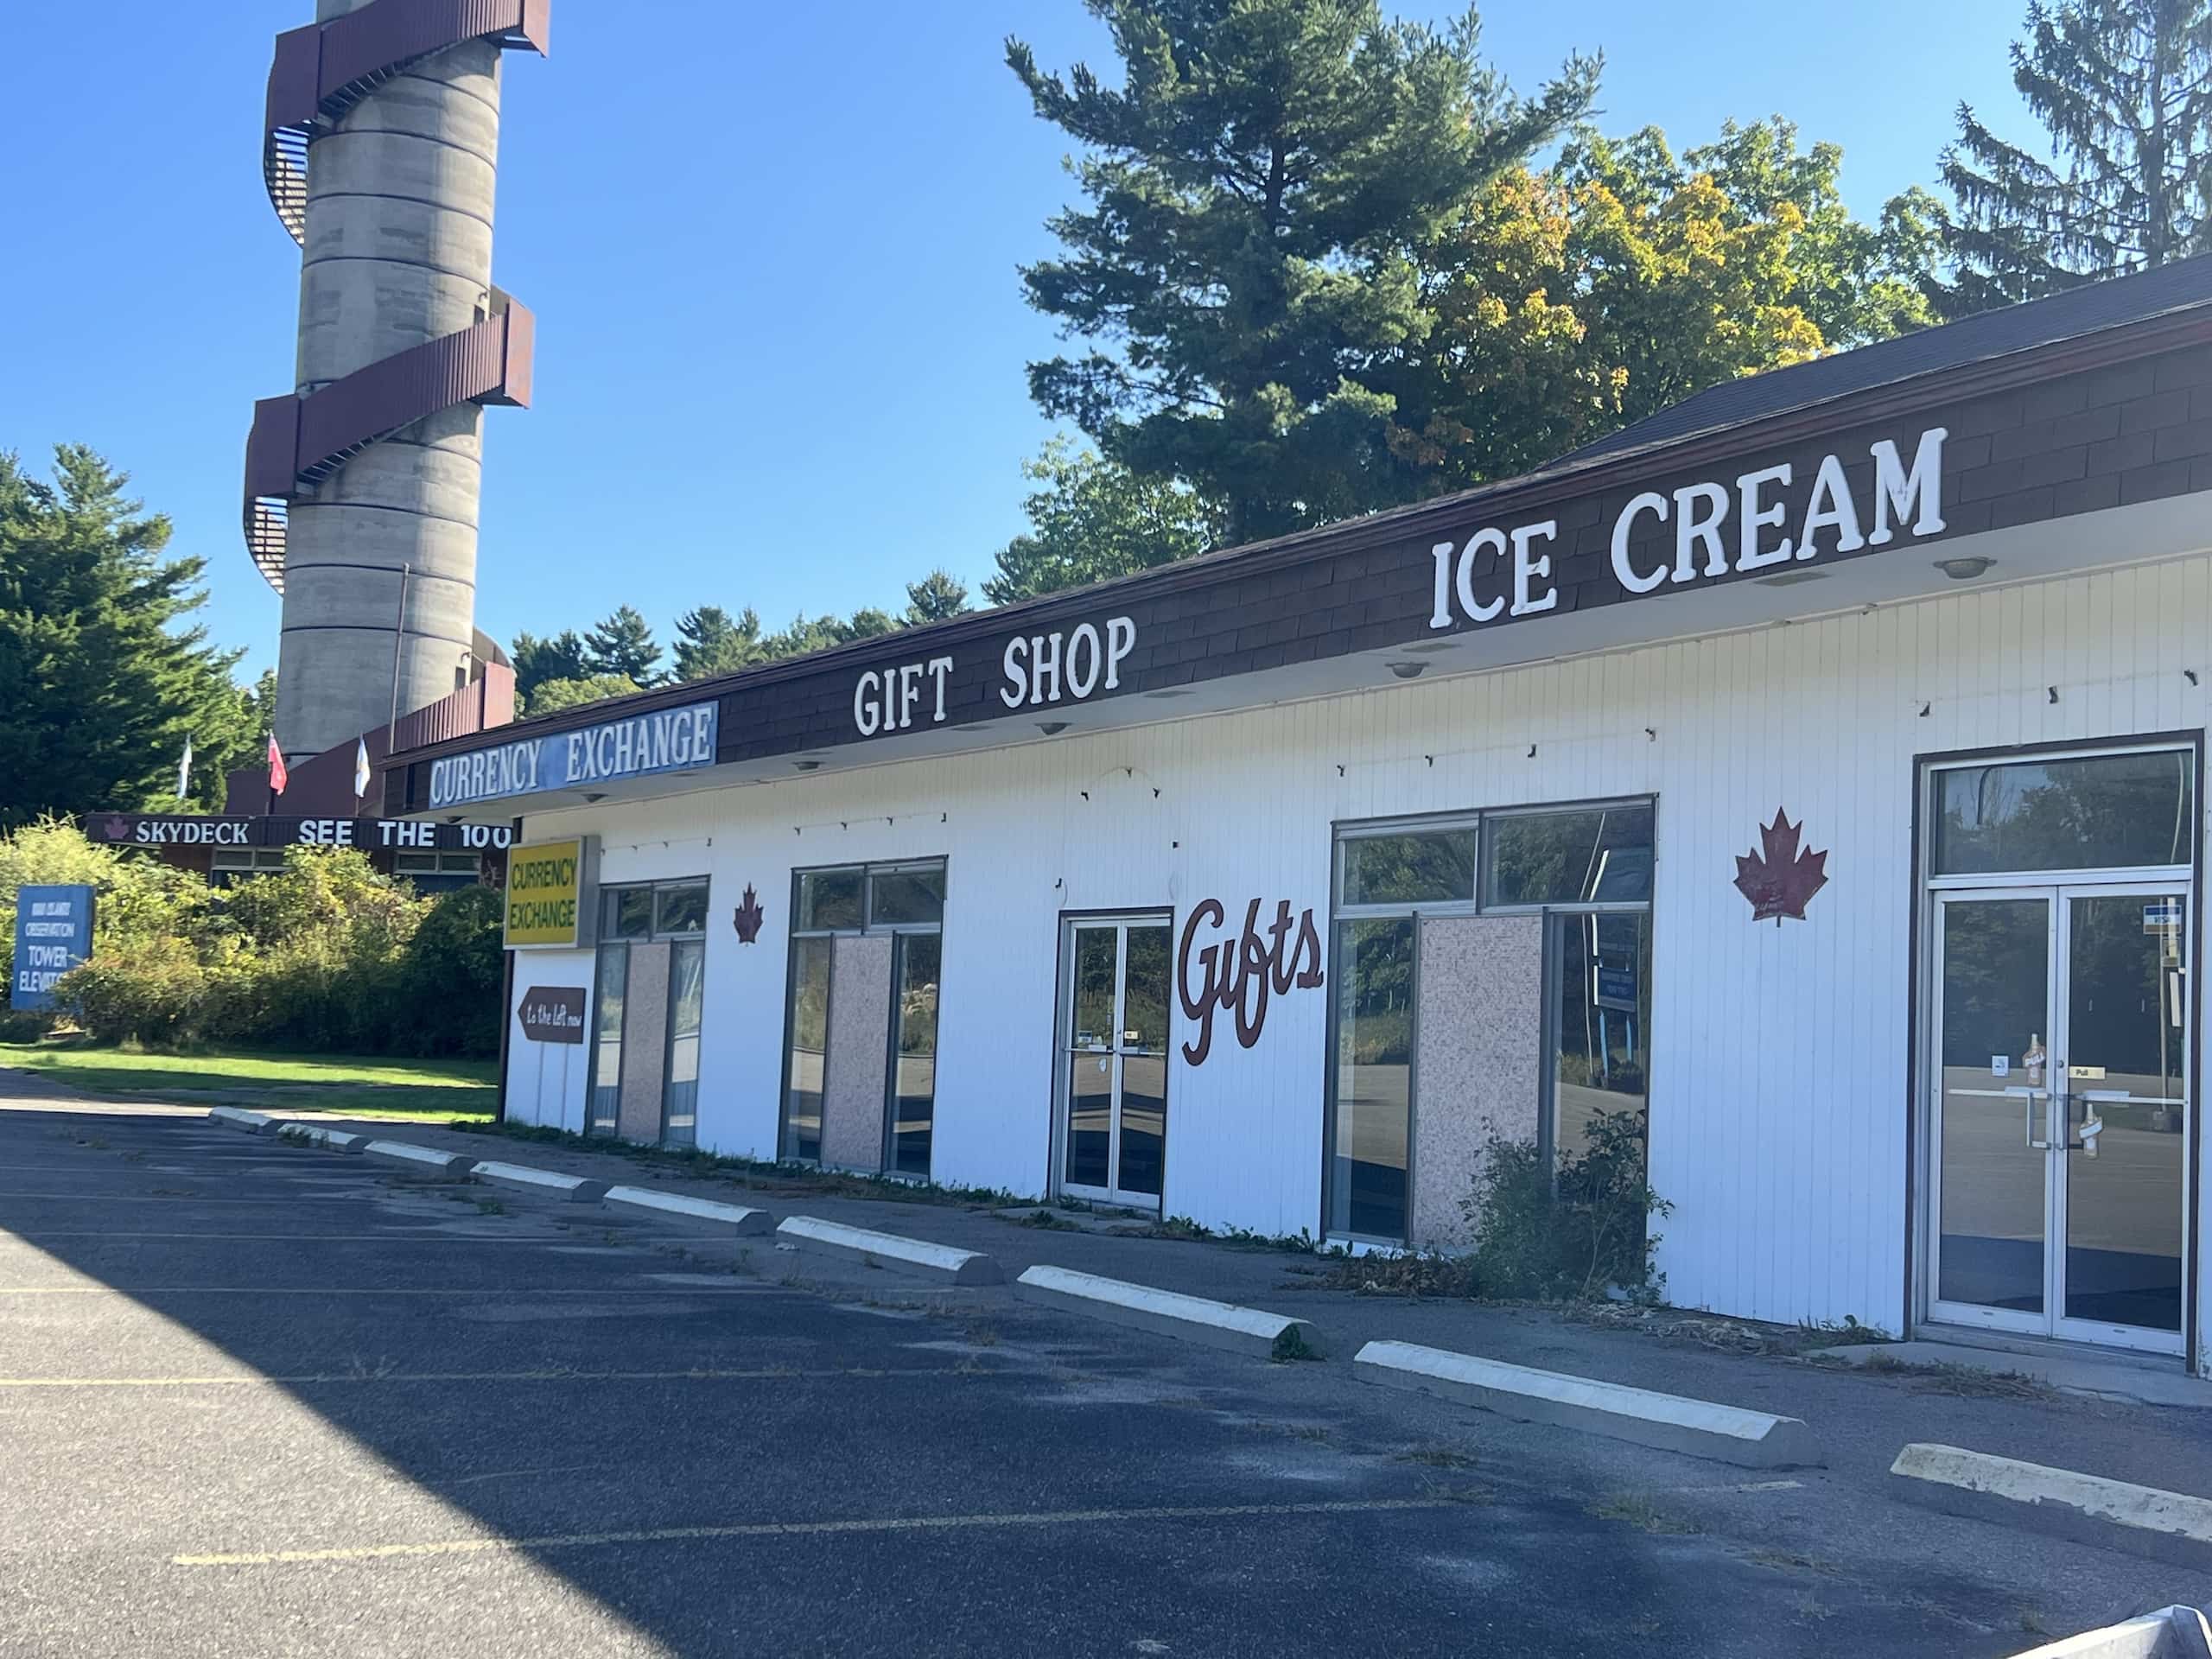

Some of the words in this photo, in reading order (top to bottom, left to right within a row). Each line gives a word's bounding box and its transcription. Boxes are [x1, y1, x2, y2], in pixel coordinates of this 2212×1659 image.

[1429, 520, 1556, 629] ICE
[1611, 427, 1948, 593] CREAM
[855, 657, 954, 735] GIFT
[1000, 616, 1136, 709] SHOP
[431, 740, 543, 804] CURRENCY
[566, 707, 714, 782] EXCHANGE
[135, 821, 250, 845] SKYDECK
[299, 820, 353, 845] SEE
[378, 821, 436, 847] THE
[461, 824, 512, 849] 100
[511, 858, 578, 891] CURRENCY
[509, 900, 575, 930] EXCHANGE
[28, 945, 67, 968] TOWER
[1178, 898, 1324, 1066] Gifts
